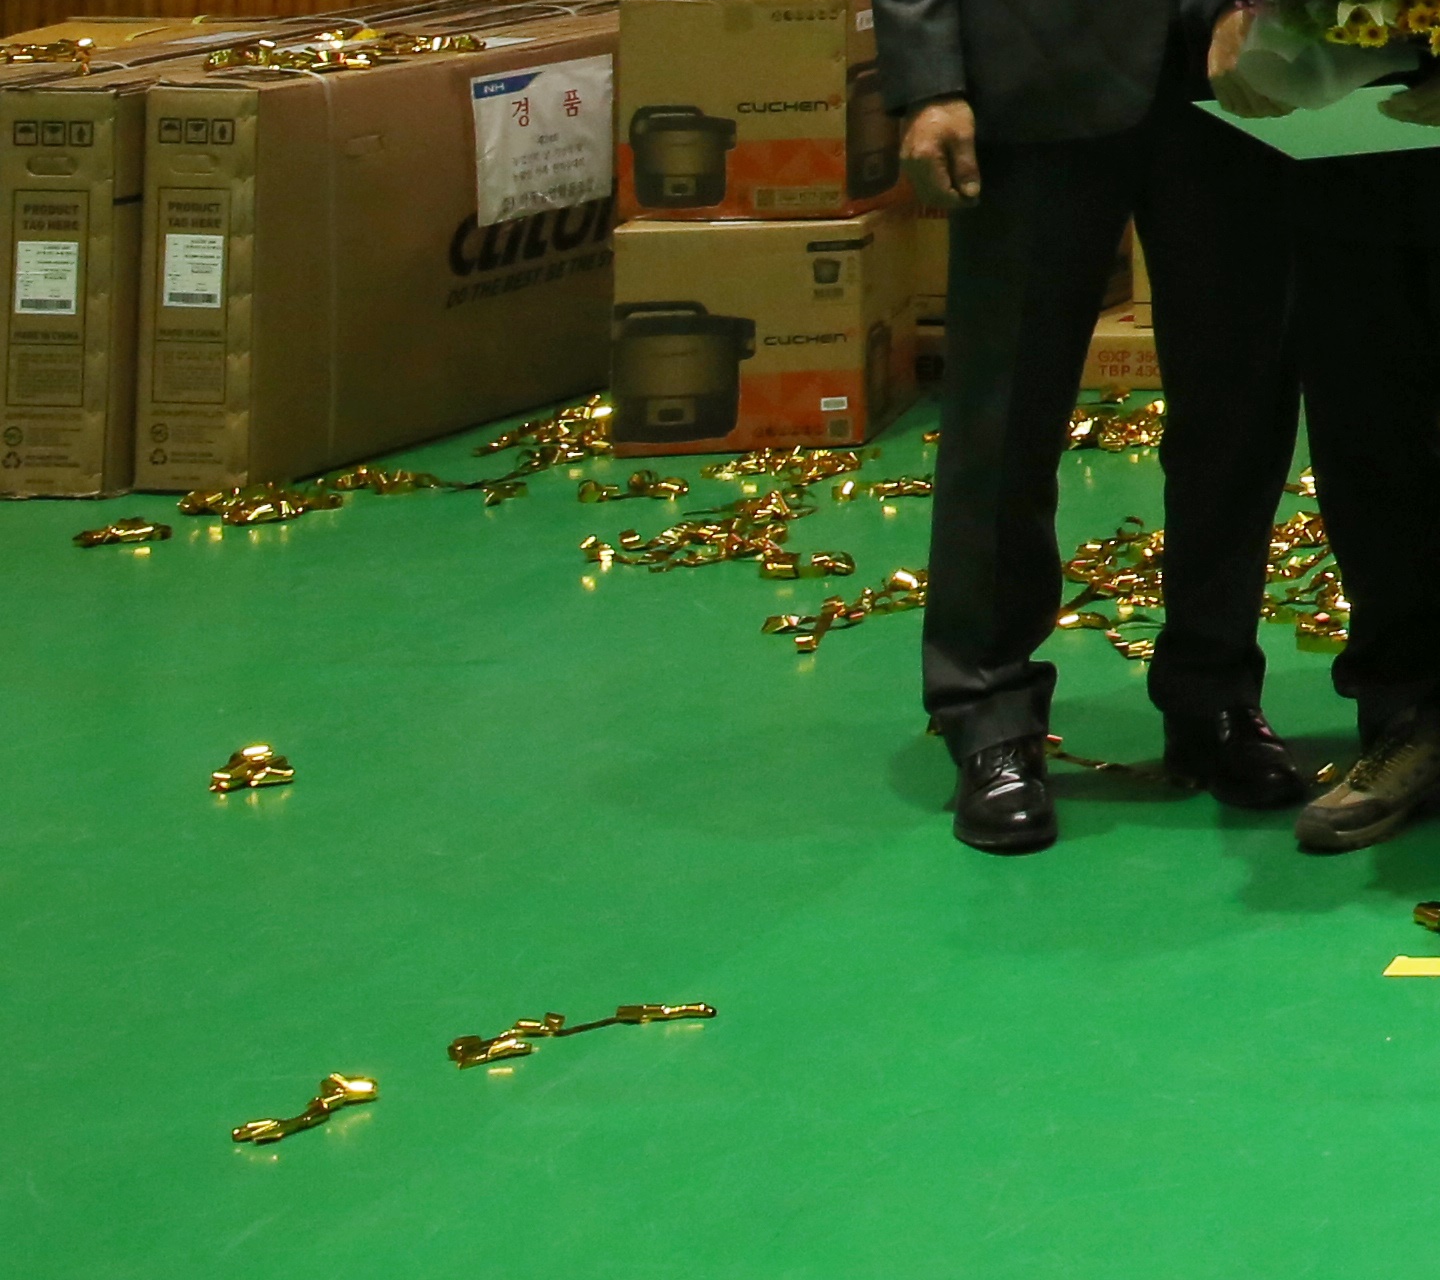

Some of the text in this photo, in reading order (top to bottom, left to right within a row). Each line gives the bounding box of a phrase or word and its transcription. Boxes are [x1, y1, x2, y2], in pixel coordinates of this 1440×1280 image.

[484, 83, 505, 93] NH
[737, 100, 828, 114] CUCHEN
[764, 332, 847, 346] CUCHEN
